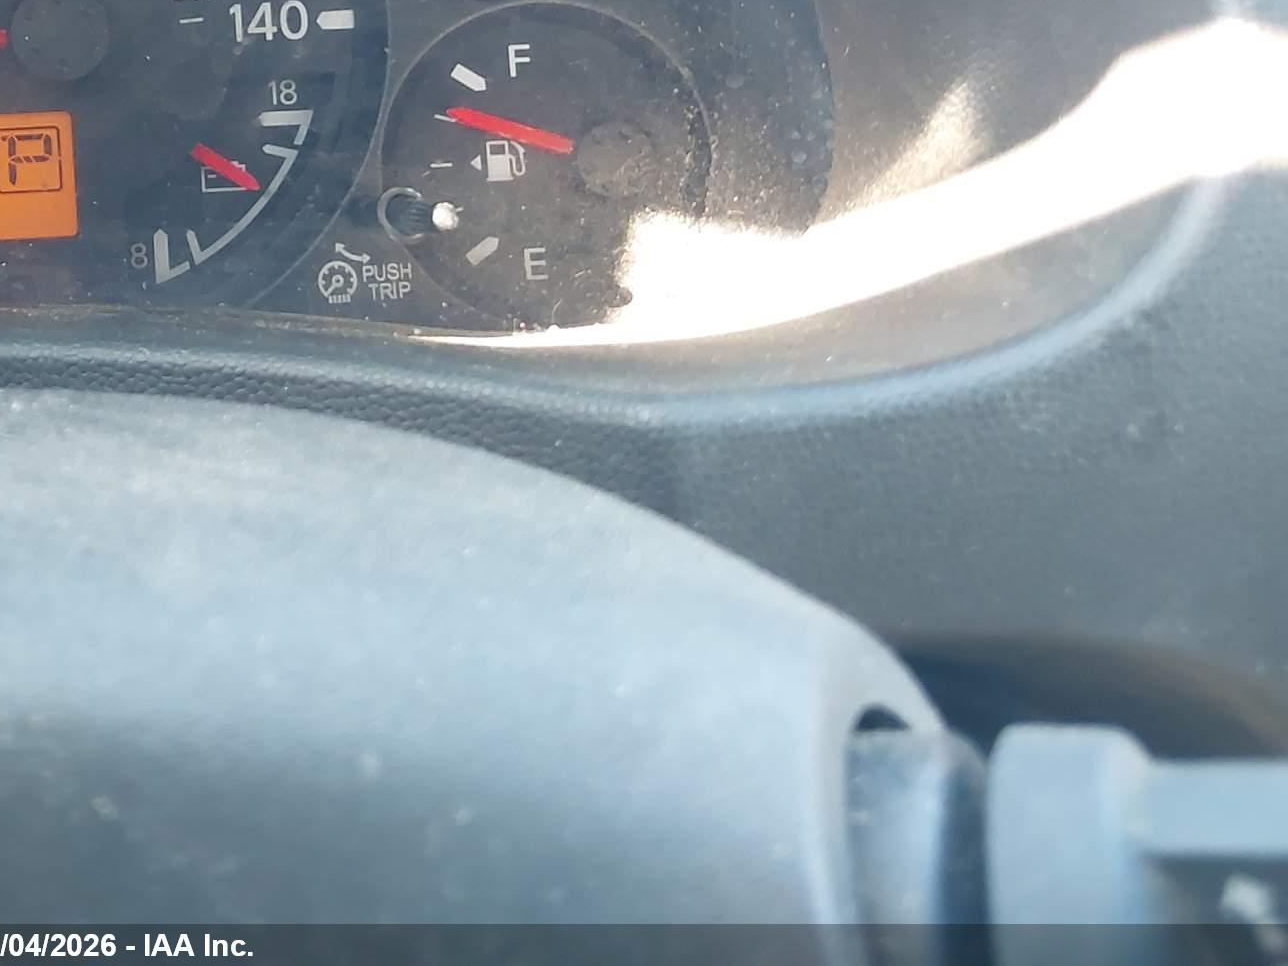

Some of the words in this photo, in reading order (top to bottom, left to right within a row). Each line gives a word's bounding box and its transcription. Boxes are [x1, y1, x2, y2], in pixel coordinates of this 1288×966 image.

[229, 0, 309, 42] 140
[508, 44, 531, 77] F
[271, 80, 298, 106] 18
[1, 133, 52, 185] P
[130, 244, 148, 270] 8
[525, 247, 549, 280] E
[362, 263, 412, 282] PUSH
[368, 282, 411, 301] TRIP
